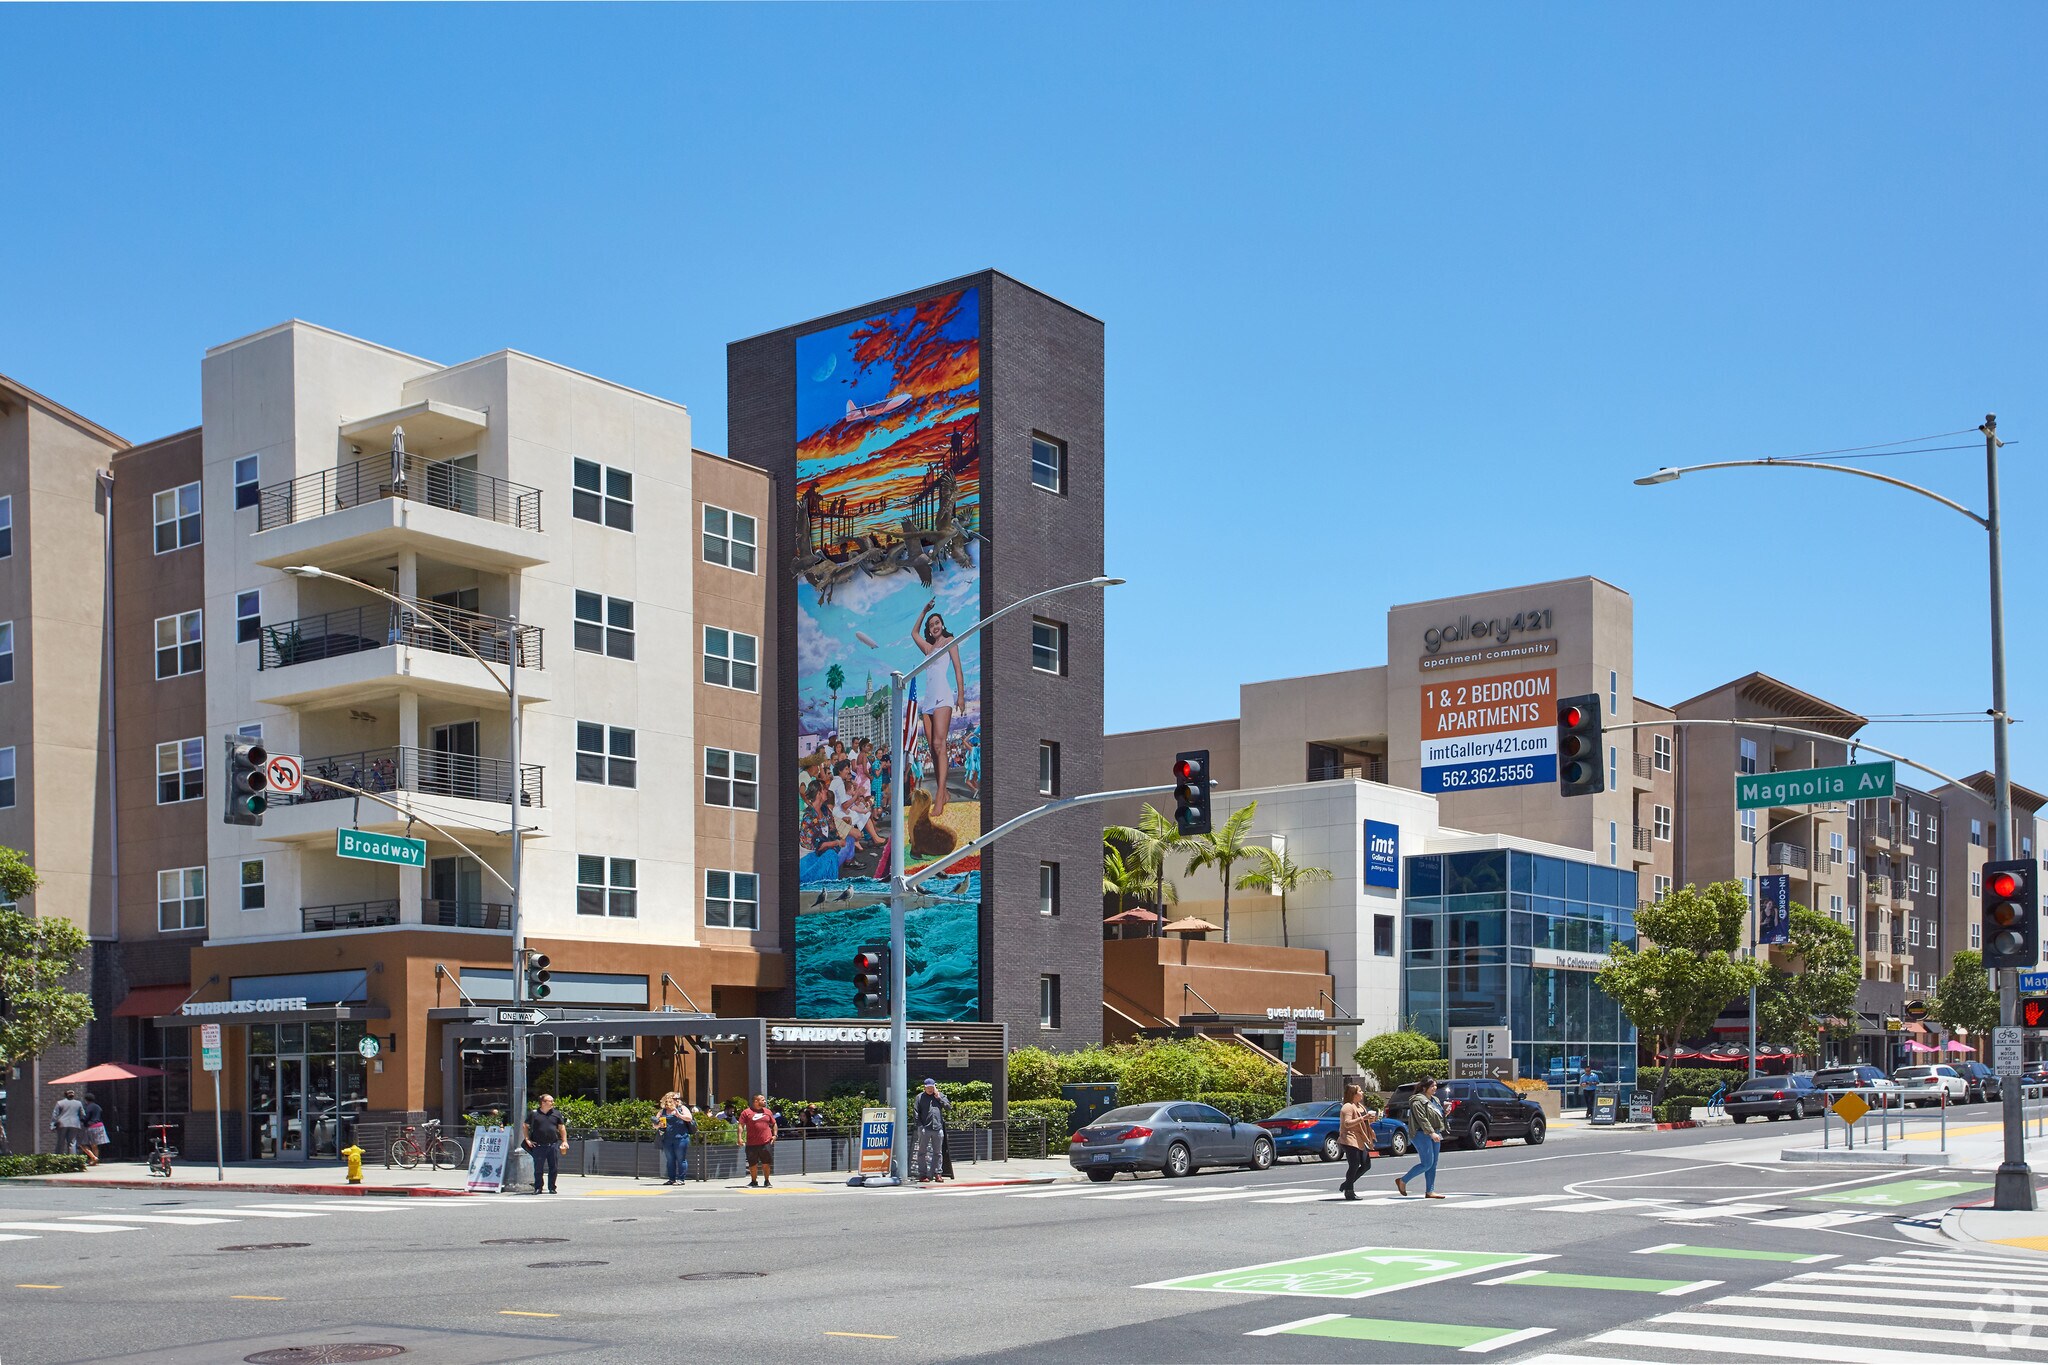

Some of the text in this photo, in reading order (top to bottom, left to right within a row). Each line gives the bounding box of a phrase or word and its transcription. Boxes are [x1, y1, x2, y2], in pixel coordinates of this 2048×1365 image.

[1424, 609, 1552, 653] gallery421
[1424, 644, 1550, 668] apartment community
[1426, 676, 1550, 709] 1 & 2 BEDROOM
[1437, 702, 1540, 732] APARTMENTS
[1429, 737, 1548, 761] imtGallery421.com
[1442, 763, 1534, 787] 562.362.5556
[1743, 772, 1886, 804] Magnolia Av
[344, 836, 419, 863] Broadway
[1371, 835, 1394, 854] imt
[1371, 853, 1386, 863] Gallery
[1556, 956, 1566, 967] The
[182, 997, 307, 1016] STARBUCKS COFFEE
[1266, 1006, 1325, 1021] guest parking
[519, 1013, 534, 1021] WAY
[771, 1027, 923, 1043] STARBUCKS COEE
[873, 1111, 887, 1119] imt
[869, 1123, 889, 1135] LEASE
[478, 1144, 501, 1153] BROILER
[480, 1137, 498, 1145] FLAME
[866, 1137, 889, 1148] TODAY!
